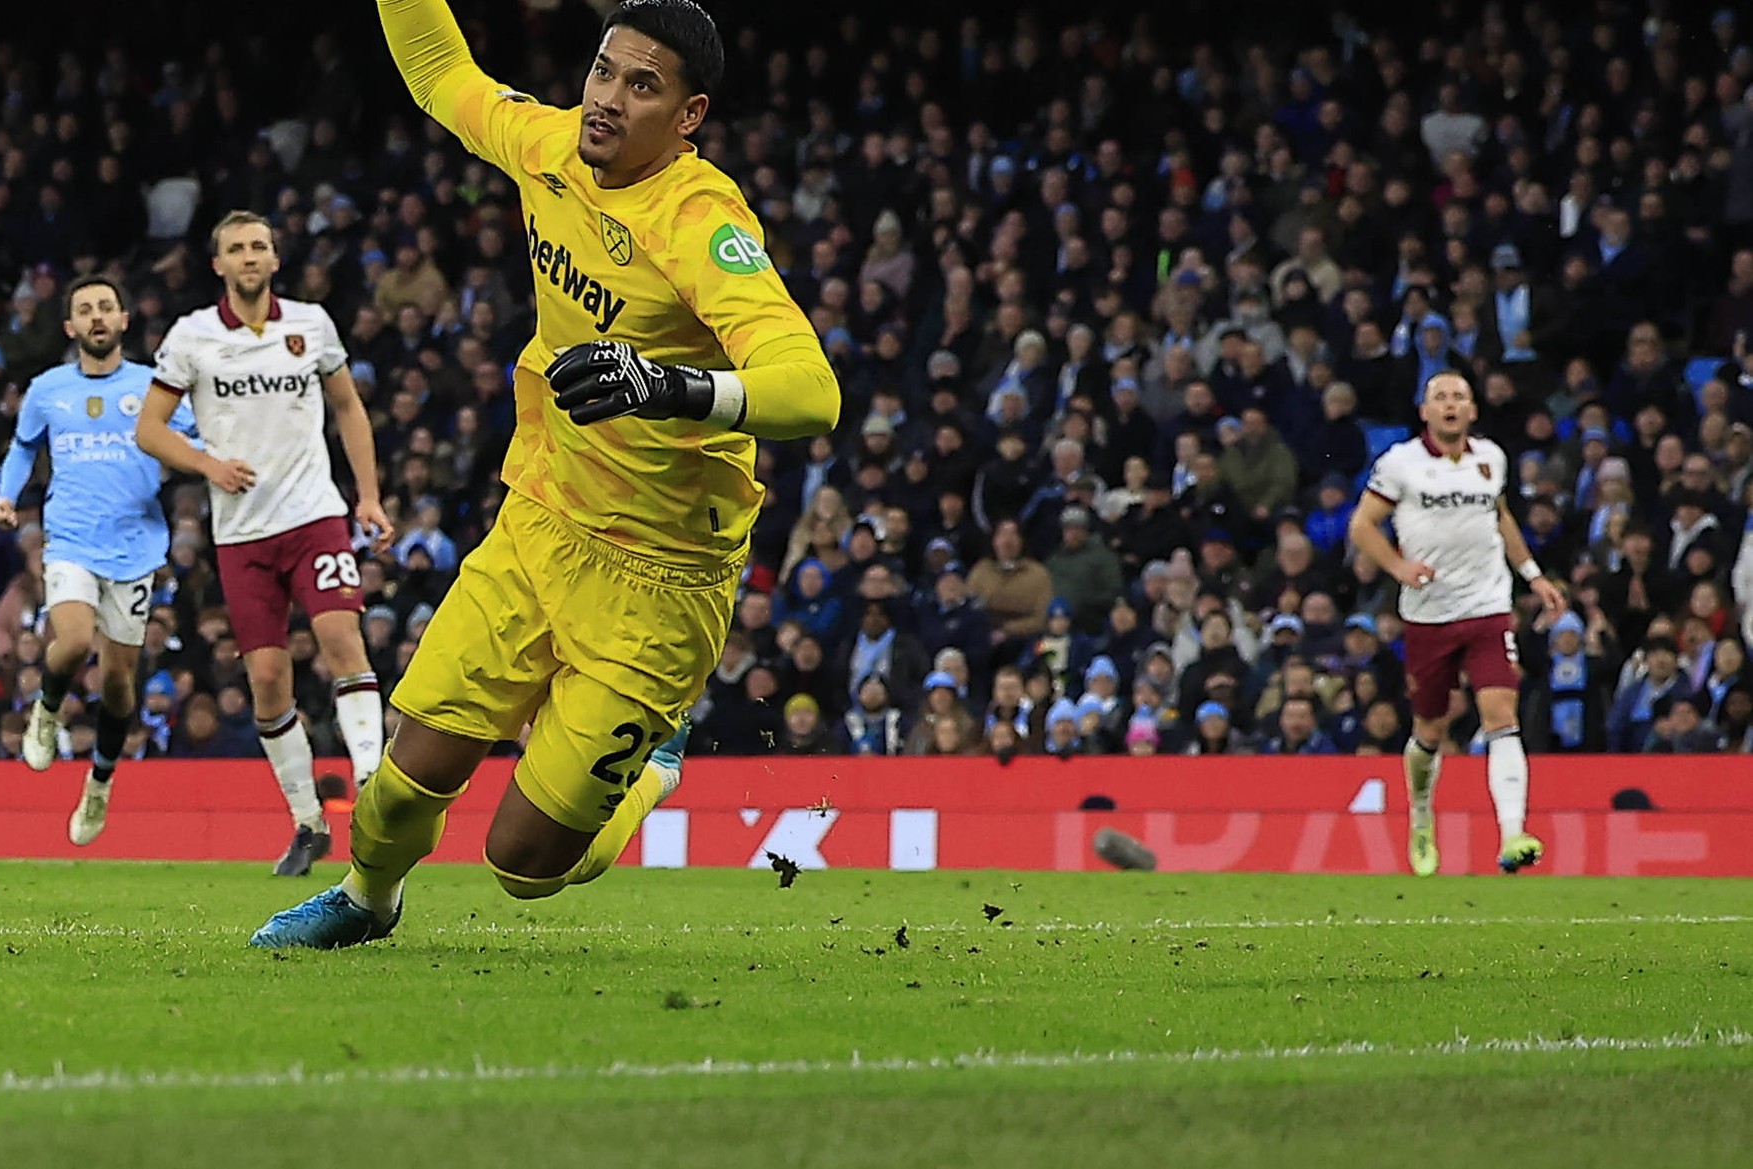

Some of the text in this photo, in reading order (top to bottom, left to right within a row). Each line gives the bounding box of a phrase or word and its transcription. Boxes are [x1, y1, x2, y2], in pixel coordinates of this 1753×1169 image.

[528, 214, 627, 334] betway
[213, 372, 311, 398] betway
[313, 550, 362, 592] 28
